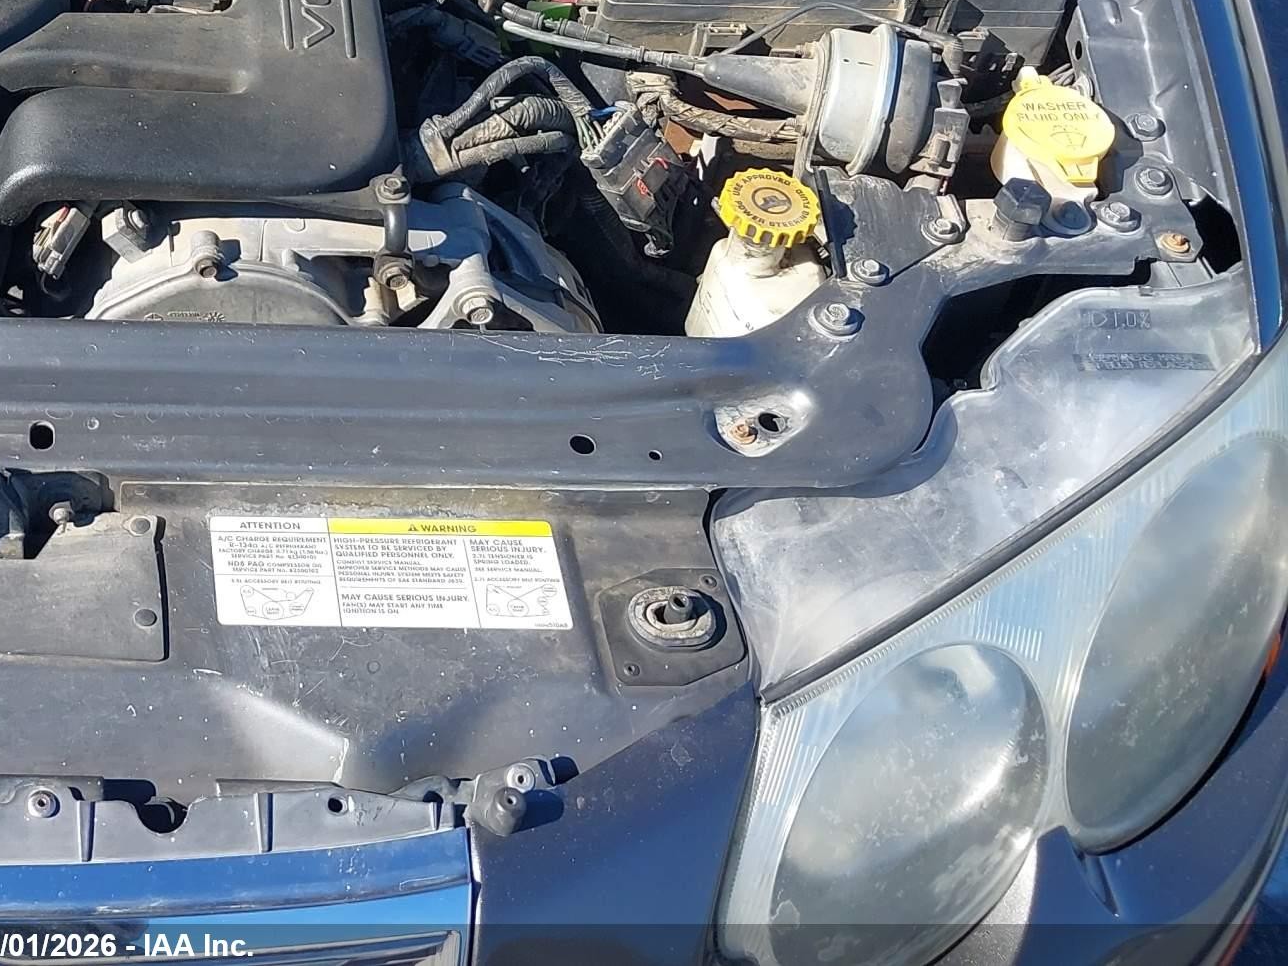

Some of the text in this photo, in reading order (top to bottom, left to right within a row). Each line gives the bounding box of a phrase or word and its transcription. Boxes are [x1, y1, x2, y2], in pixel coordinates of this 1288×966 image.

[1021, 101, 1087, 112] WASHER
[1016, 112, 1100, 123] FLUID ONLY
[732, 173, 791, 196] USE APPROVED
[734, 188, 811, 228] POWER STEERING FLUID
[239, 521, 301, 530] ATTENTION
[420, 524, 477, 533] WARNING
[469, 538, 490, 546] MAY
[341, 593, 361, 601] MAY
[436, 594, 470, 602] INJURY.
